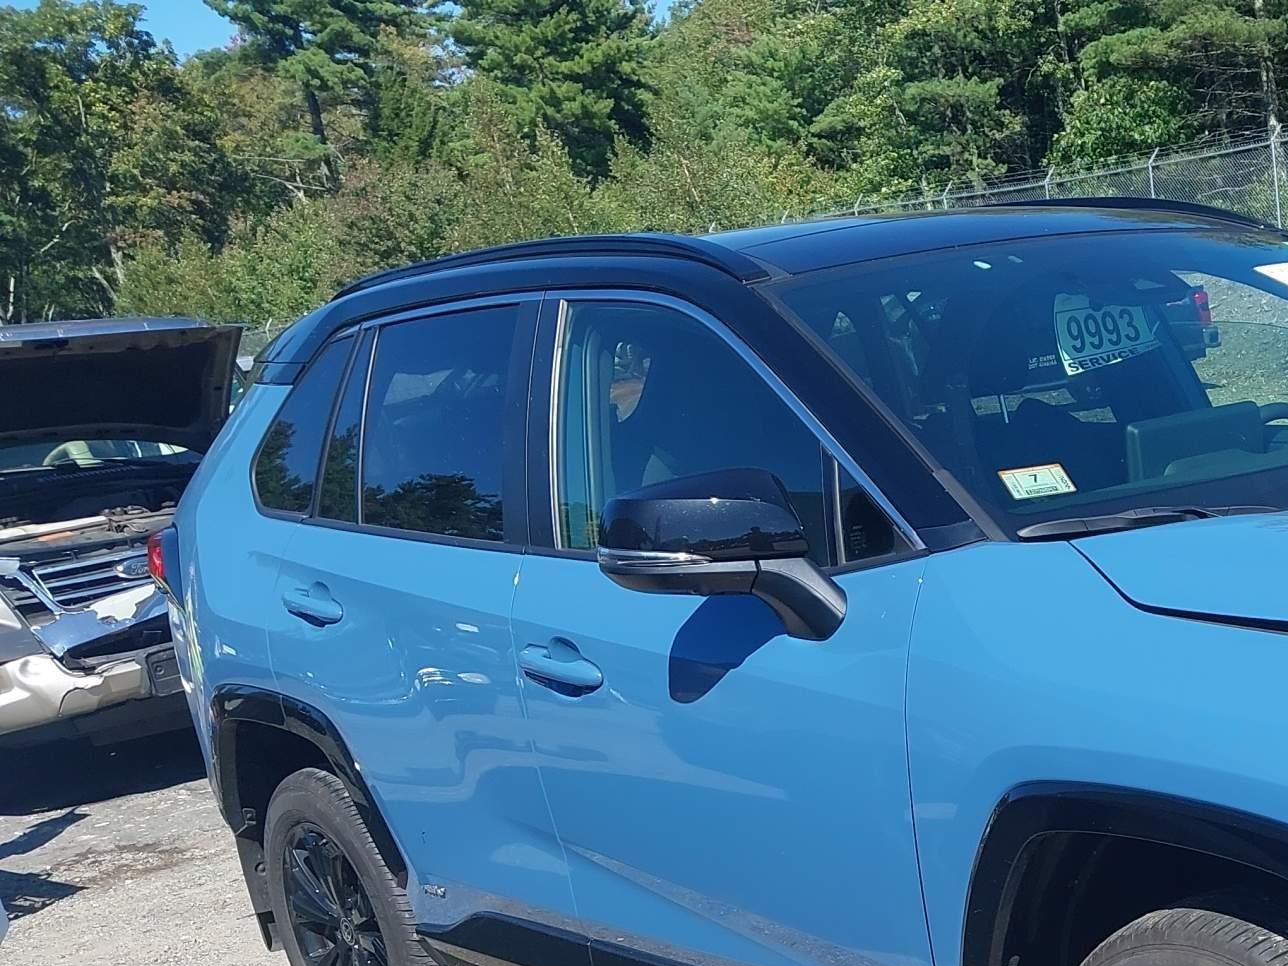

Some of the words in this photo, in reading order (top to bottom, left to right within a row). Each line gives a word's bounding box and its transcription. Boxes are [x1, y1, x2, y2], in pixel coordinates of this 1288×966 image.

[1066, 308, 1141, 353] 9993
[1068, 347, 1139, 372] SERVICE
[1028, 474, 1038, 484] 7
[130, 562, 149, 576] For
